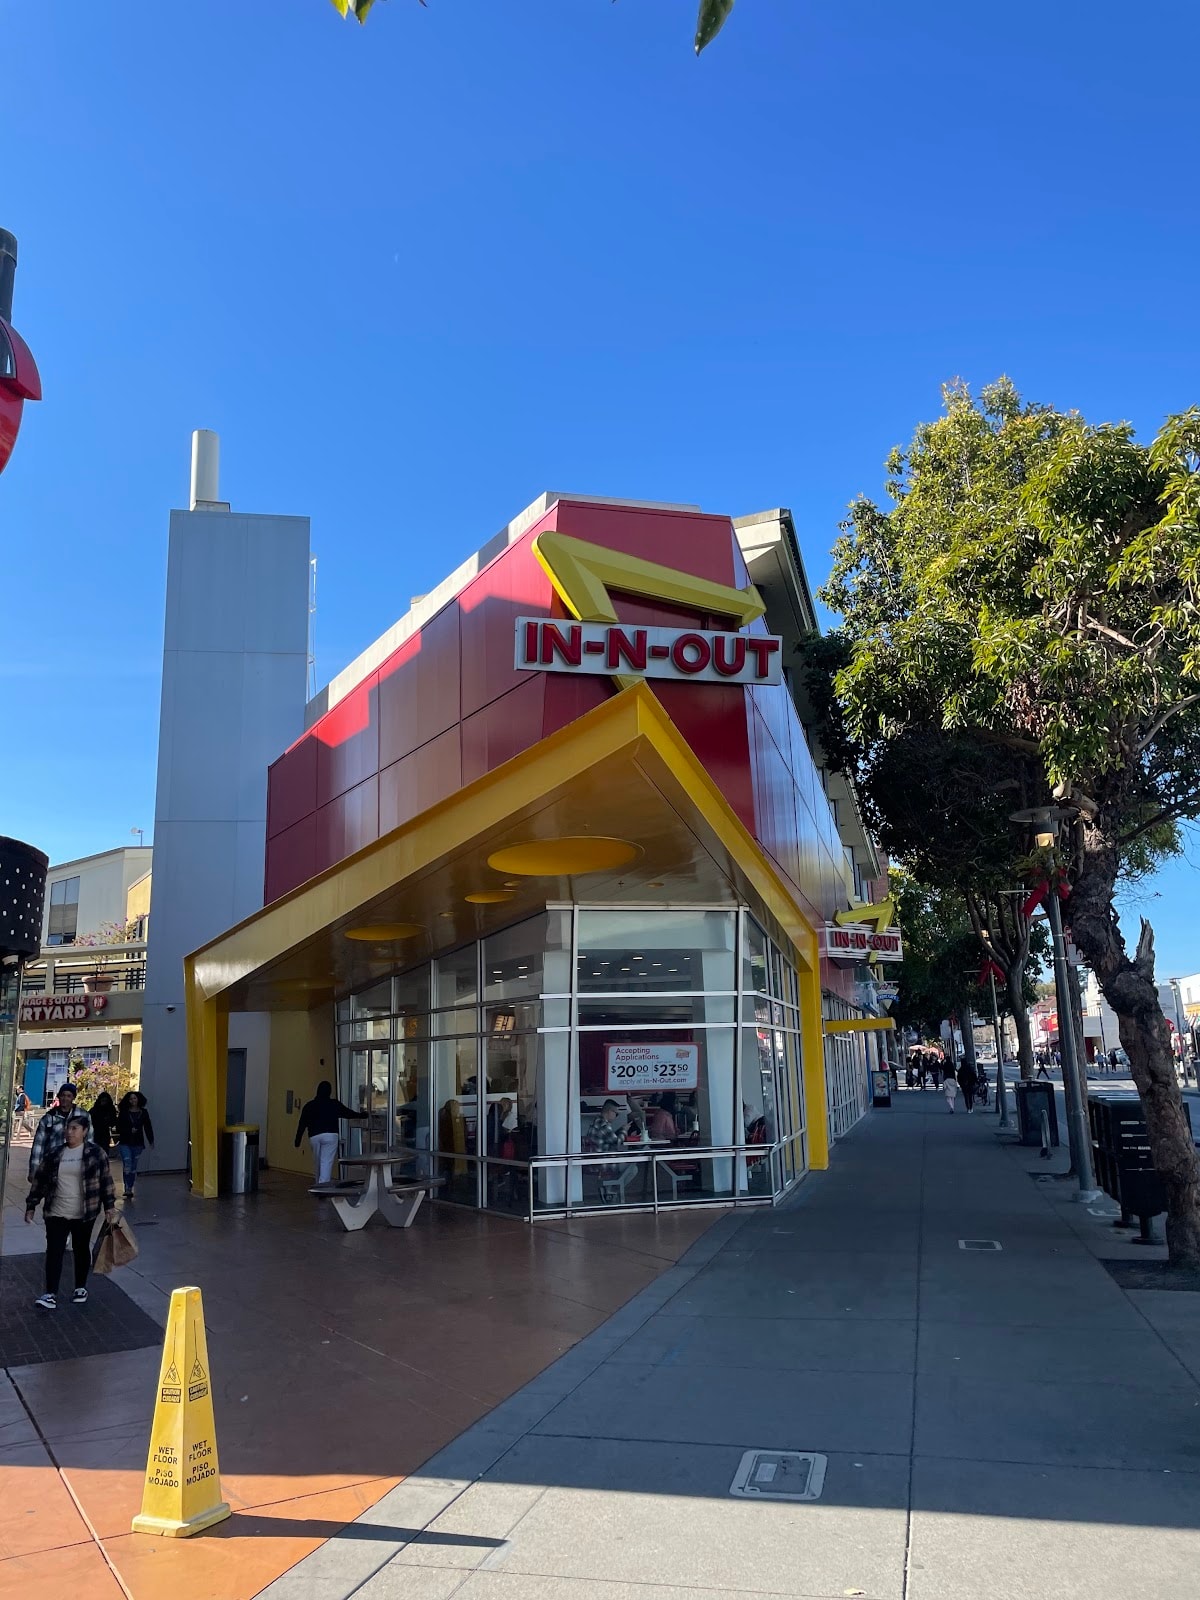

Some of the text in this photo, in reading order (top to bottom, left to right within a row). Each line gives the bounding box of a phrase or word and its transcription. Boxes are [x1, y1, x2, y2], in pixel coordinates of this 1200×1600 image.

[524, 621, 780, 678] IN-N-OUT
[831, 931, 900, 951] IN-N-OUT
[48, 995, 86, 1006] SQUARE
[20, 1005, 87, 1021] RTYARD
[158, 1446, 174, 1455] WET
[192, 1440, 207, 1451] WET
[153, 1454, 178, 1464] FLOOR
[189, 1447, 212, 1462] FLOOR
[155, 1468, 173, 1477] PISO
[192, 1462, 209, 1474] PISO
[148, 1476, 179, 1488] MOJADO
[186, 1468, 216, 1486] MOJADO
